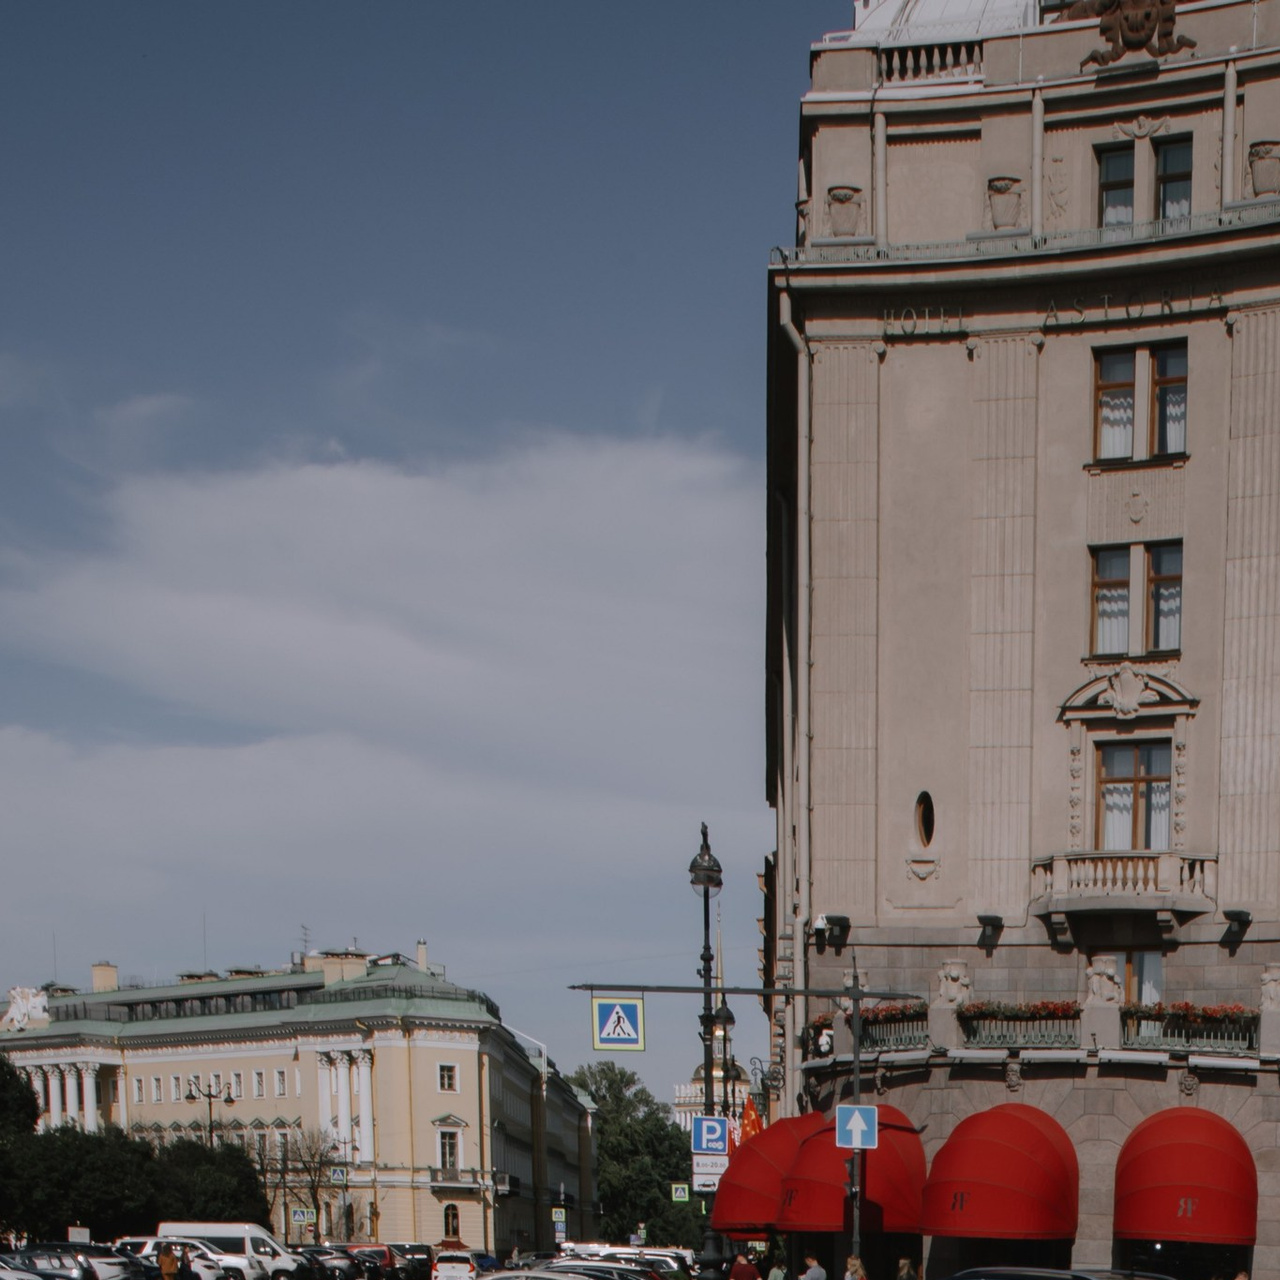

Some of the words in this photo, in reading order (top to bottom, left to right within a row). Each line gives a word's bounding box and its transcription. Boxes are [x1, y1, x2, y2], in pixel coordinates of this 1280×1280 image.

[1044, 285, 1223, 325] ASTORIA
[883, 306, 968, 335] HOTEL
[702, 1120, 721, 1149] P
